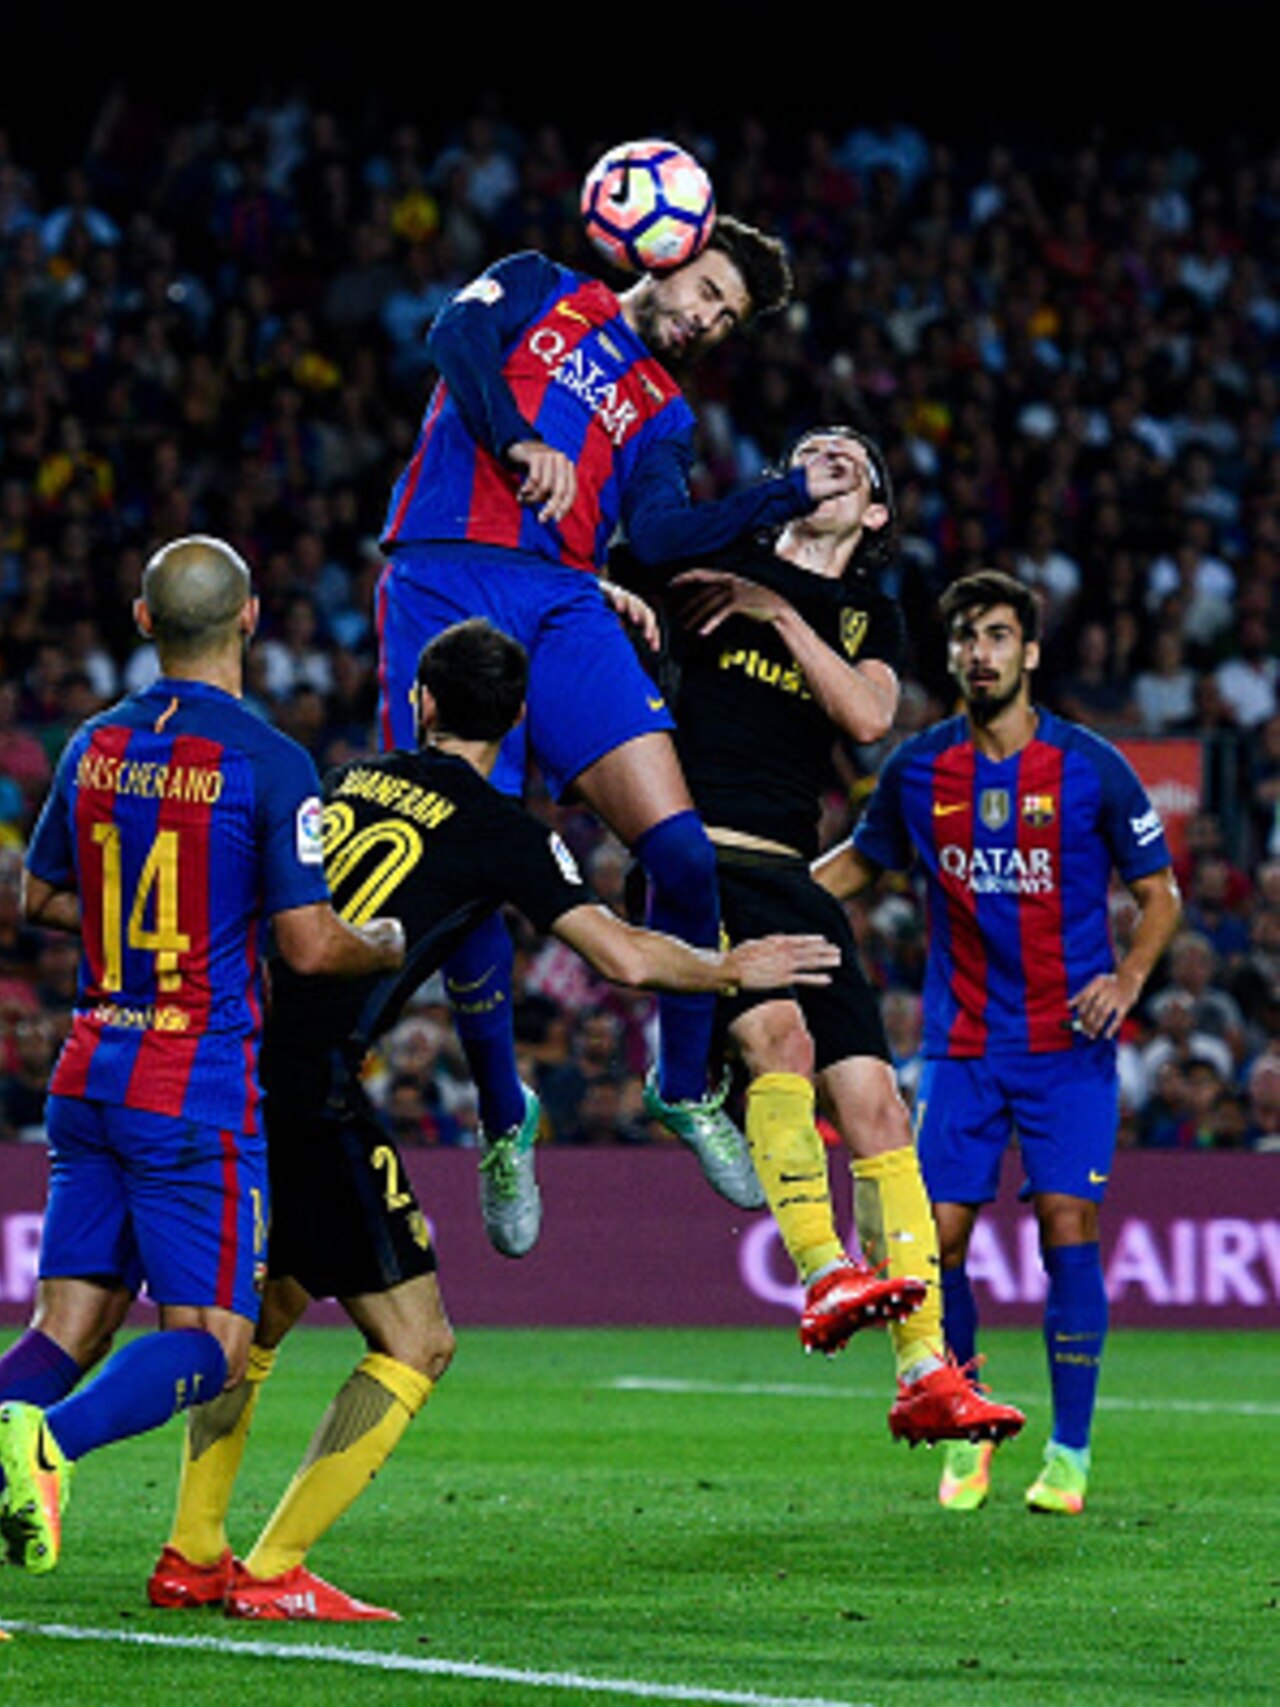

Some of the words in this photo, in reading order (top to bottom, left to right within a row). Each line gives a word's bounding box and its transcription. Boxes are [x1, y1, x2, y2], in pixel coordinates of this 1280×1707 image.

[528, 327, 638, 432] QATAR
[92, 823, 189, 992] 14
[939, 845, 1052, 880] QATAR
